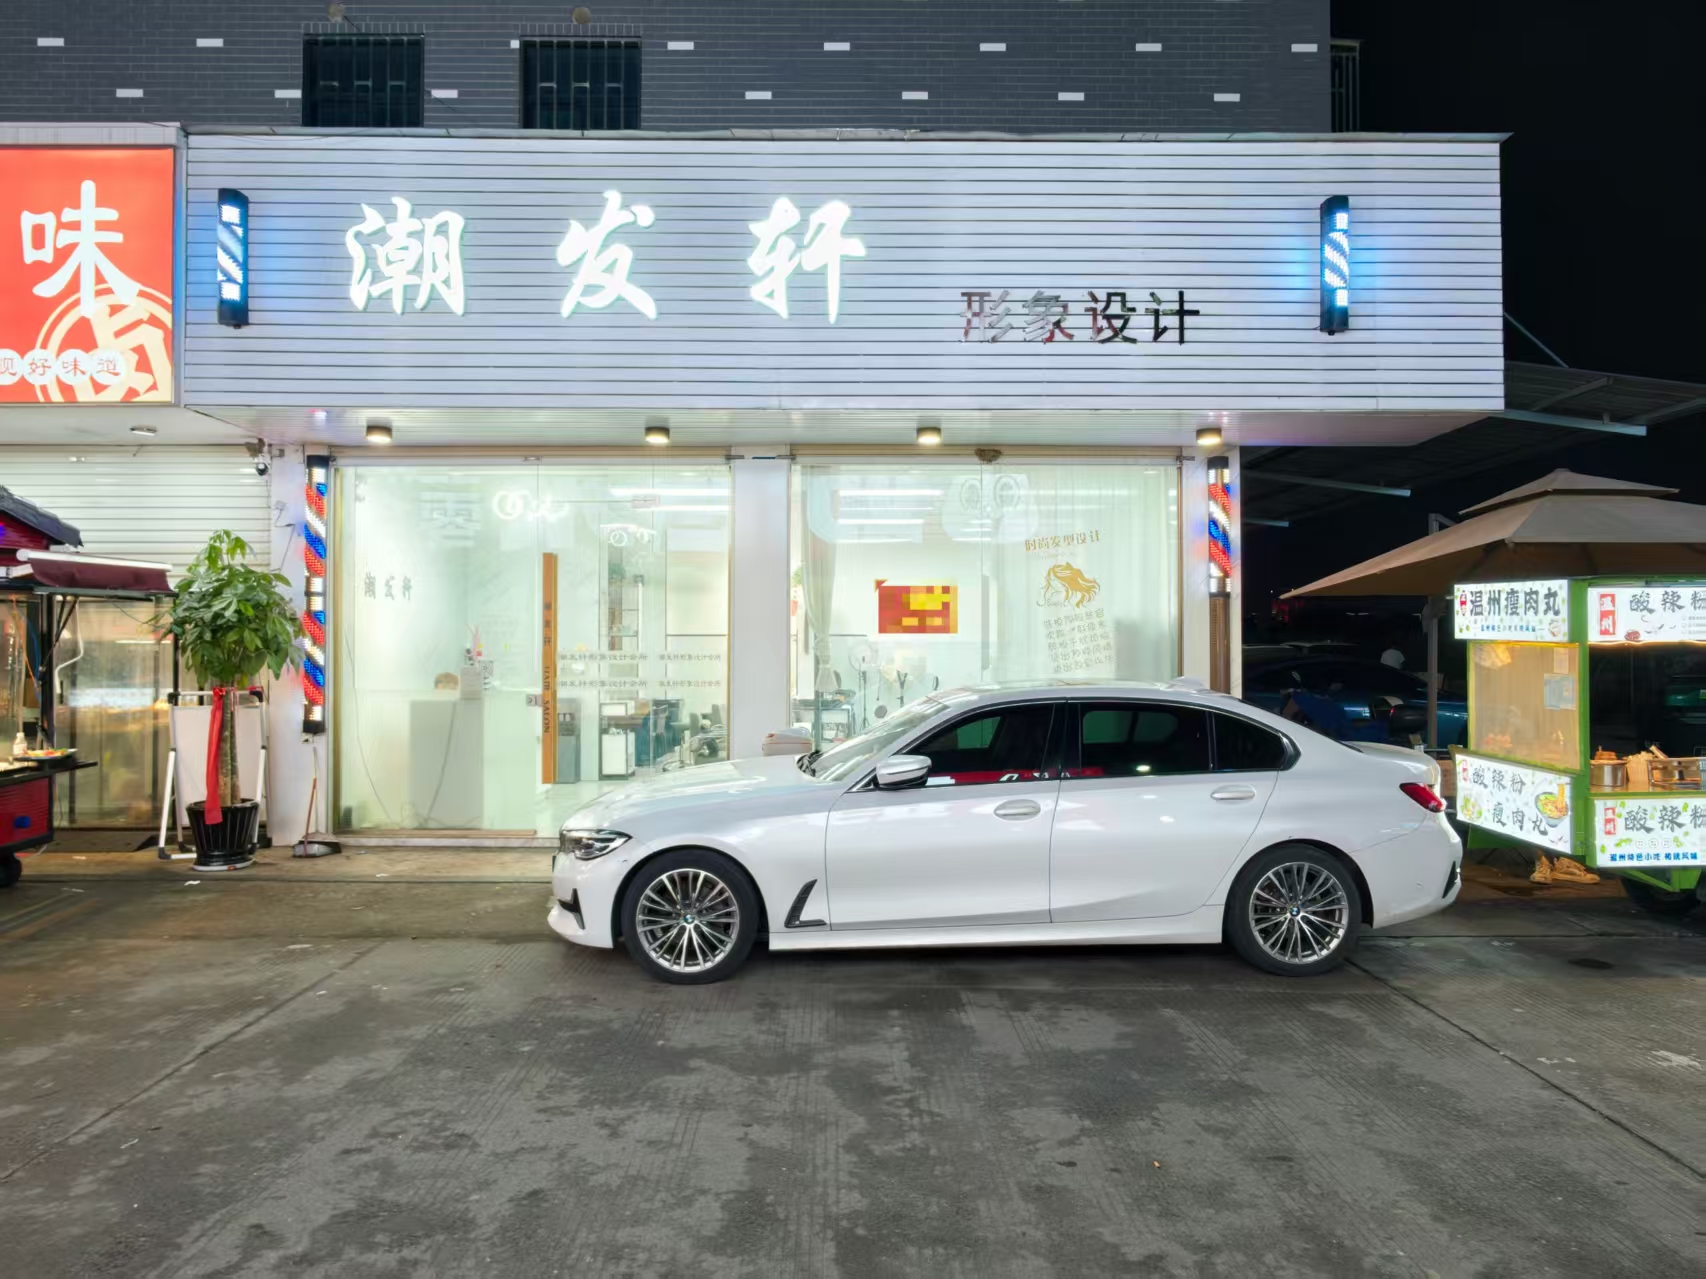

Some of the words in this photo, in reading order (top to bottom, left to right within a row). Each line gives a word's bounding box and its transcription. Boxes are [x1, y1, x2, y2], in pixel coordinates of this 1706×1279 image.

[20, 180, 140, 318] 味
[345, 189, 867, 325] 潮发轩
[960, 290, 1200, 345] 形象设计
[1025, 530, 1100, 551] 时尚发型设计
[1470, 587, 1560, 616] 温州瘦肉丸
[1472, 765, 1526, 796] 酸辣粉
[1493, 802, 1548, 836] 瘦肉丸
